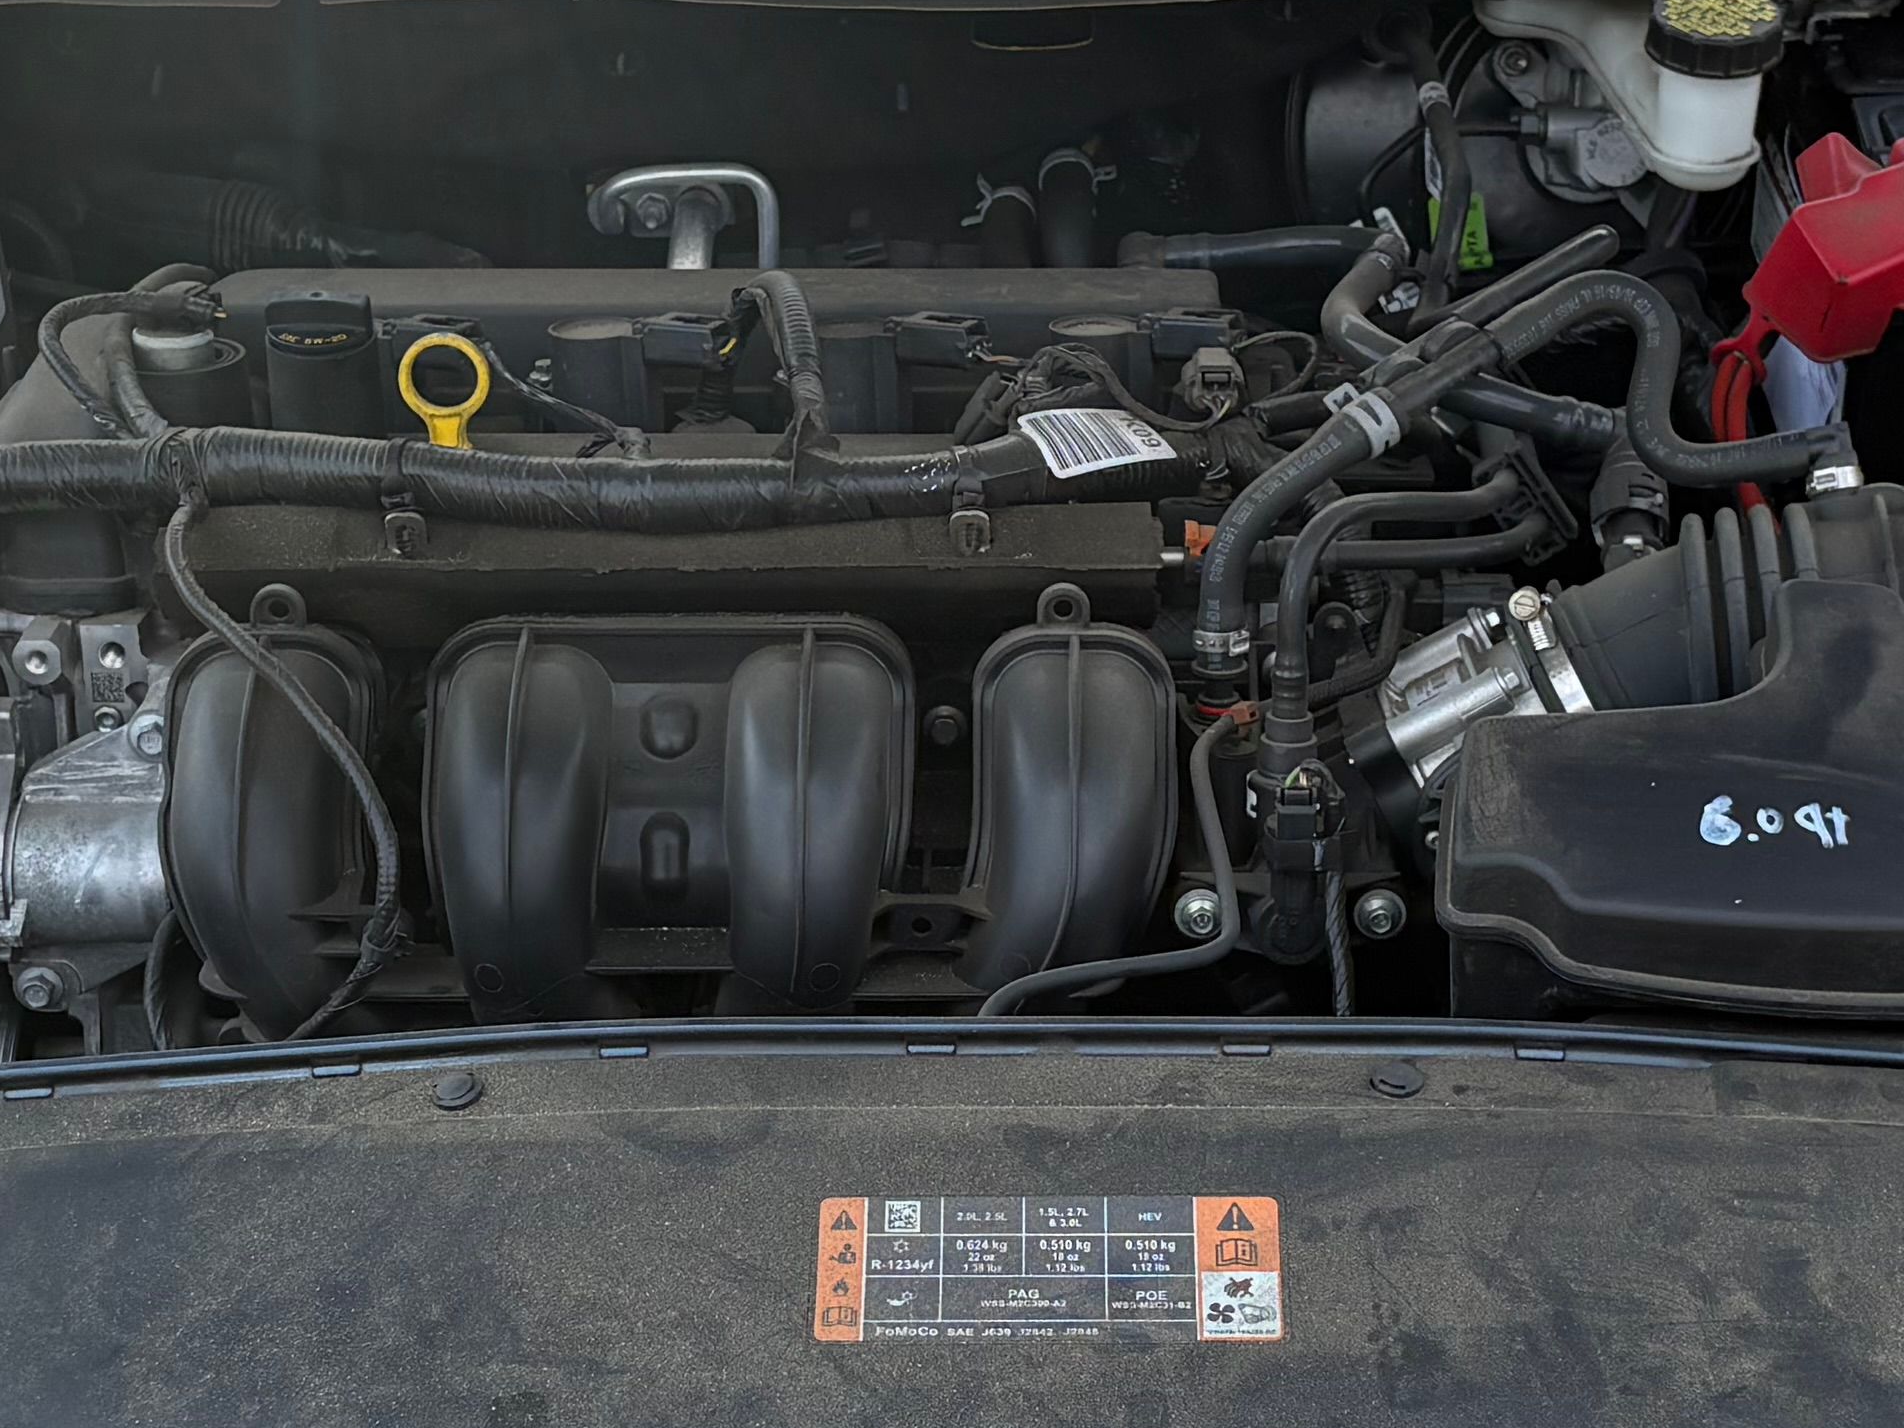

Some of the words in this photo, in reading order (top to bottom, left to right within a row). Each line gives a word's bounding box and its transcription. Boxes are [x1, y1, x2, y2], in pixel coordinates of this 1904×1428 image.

[1138, 1212, 1162, 1222] HEV
[956, 1240, 989, 1250] 0.624
[991, 1240, 1008, 1252] kg
[1039, 1240, 1072, 1250] 0.510
[1075, 1239, 1092, 1252] kg
[1125, 1240, 1158, 1250] 0.510
[1160, 1239, 1176, 1252] kg
[968, 1253, 981, 1261] 22
[871, 1259, 934, 1272] R-1234yf
[1046, 1263, 1067, 1272] 1.12
[1132, 1263, 1153, 1272] 1.12
[1154, 1263, 1171, 1272] lbs
[1008, 1288, 1040, 1299] PAG
[1135, 1290, 1169, 1301] POE
[874, 1325, 939, 1337] FoMoCo
[947, 1328, 975, 1337] SAE
